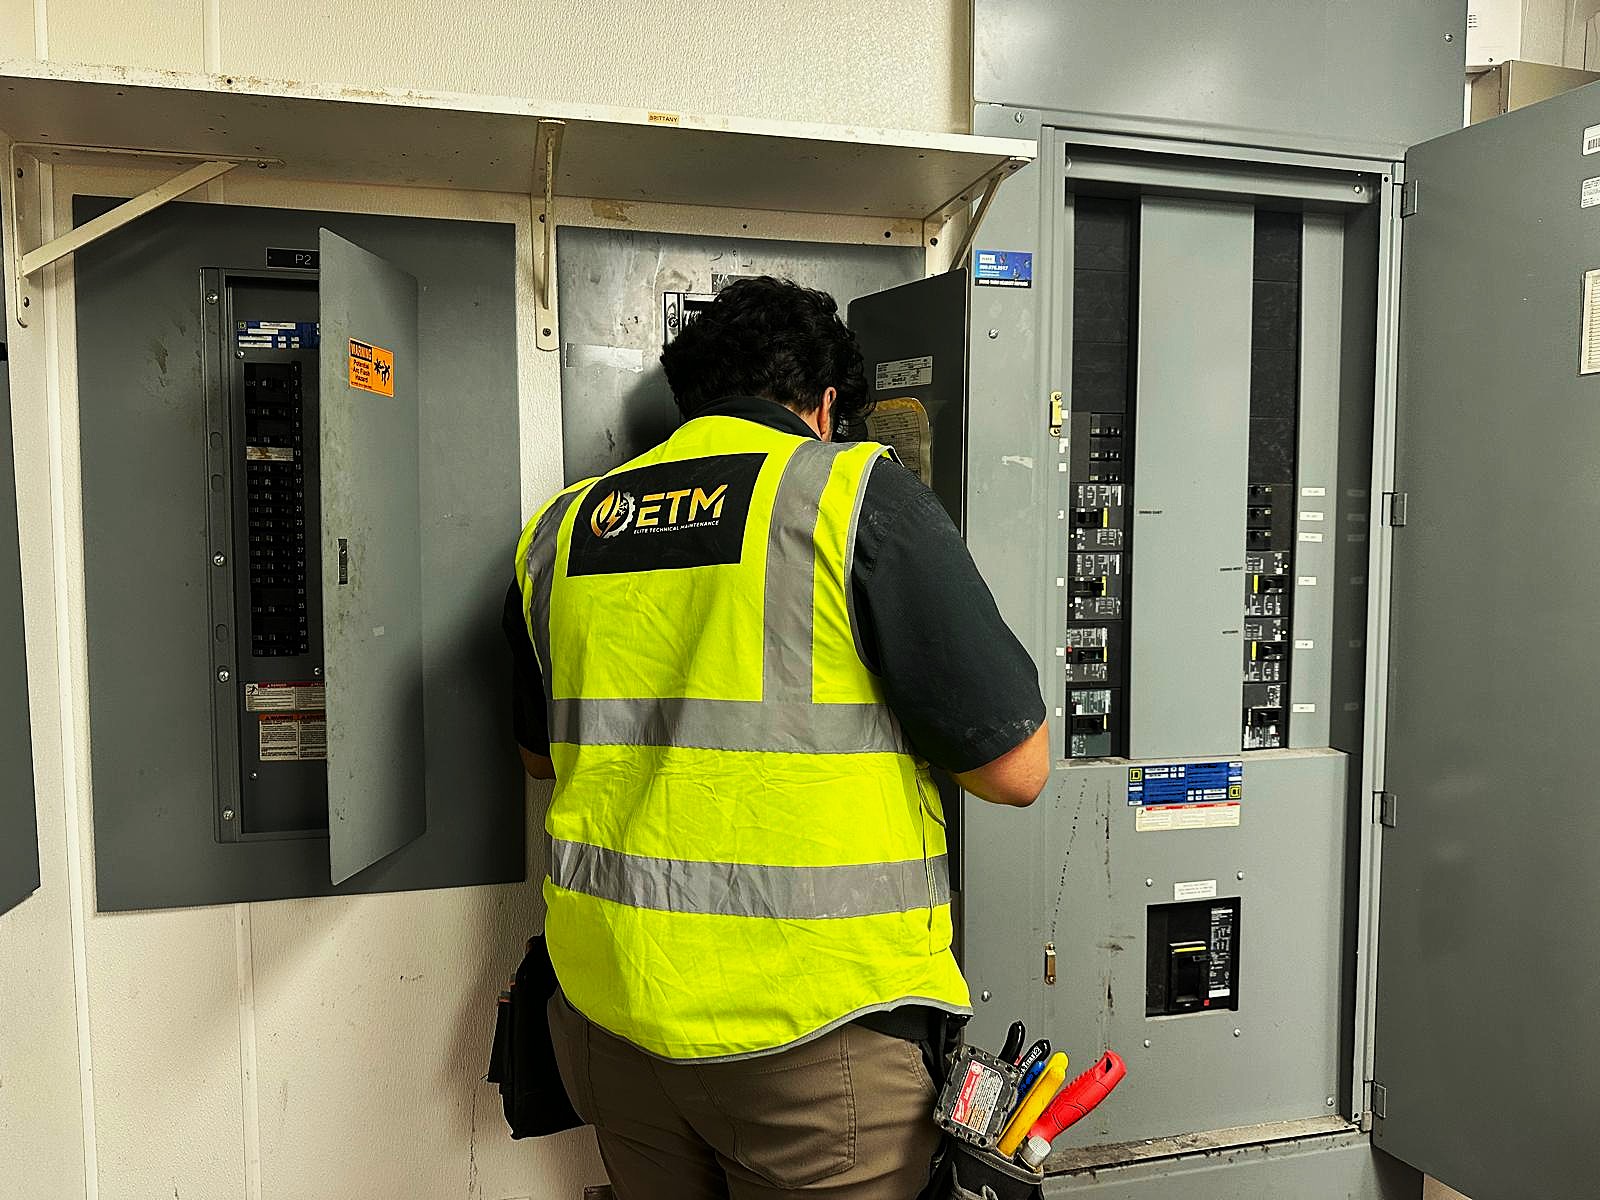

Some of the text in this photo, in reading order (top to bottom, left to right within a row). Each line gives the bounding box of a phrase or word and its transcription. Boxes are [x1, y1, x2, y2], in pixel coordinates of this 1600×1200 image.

[295, 254, 312, 265] P2
[350, 342, 372, 361] WARNING
[353, 358, 369, 370] Potential
[352, 366, 371, 376] Arc Flash
[355, 375, 368, 383] Hazard
[636, 484, 728, 527] ETM
[649, 525, 680, 533] TECHNICAL
[680, 520, 720, 529] MAINTENANCE
